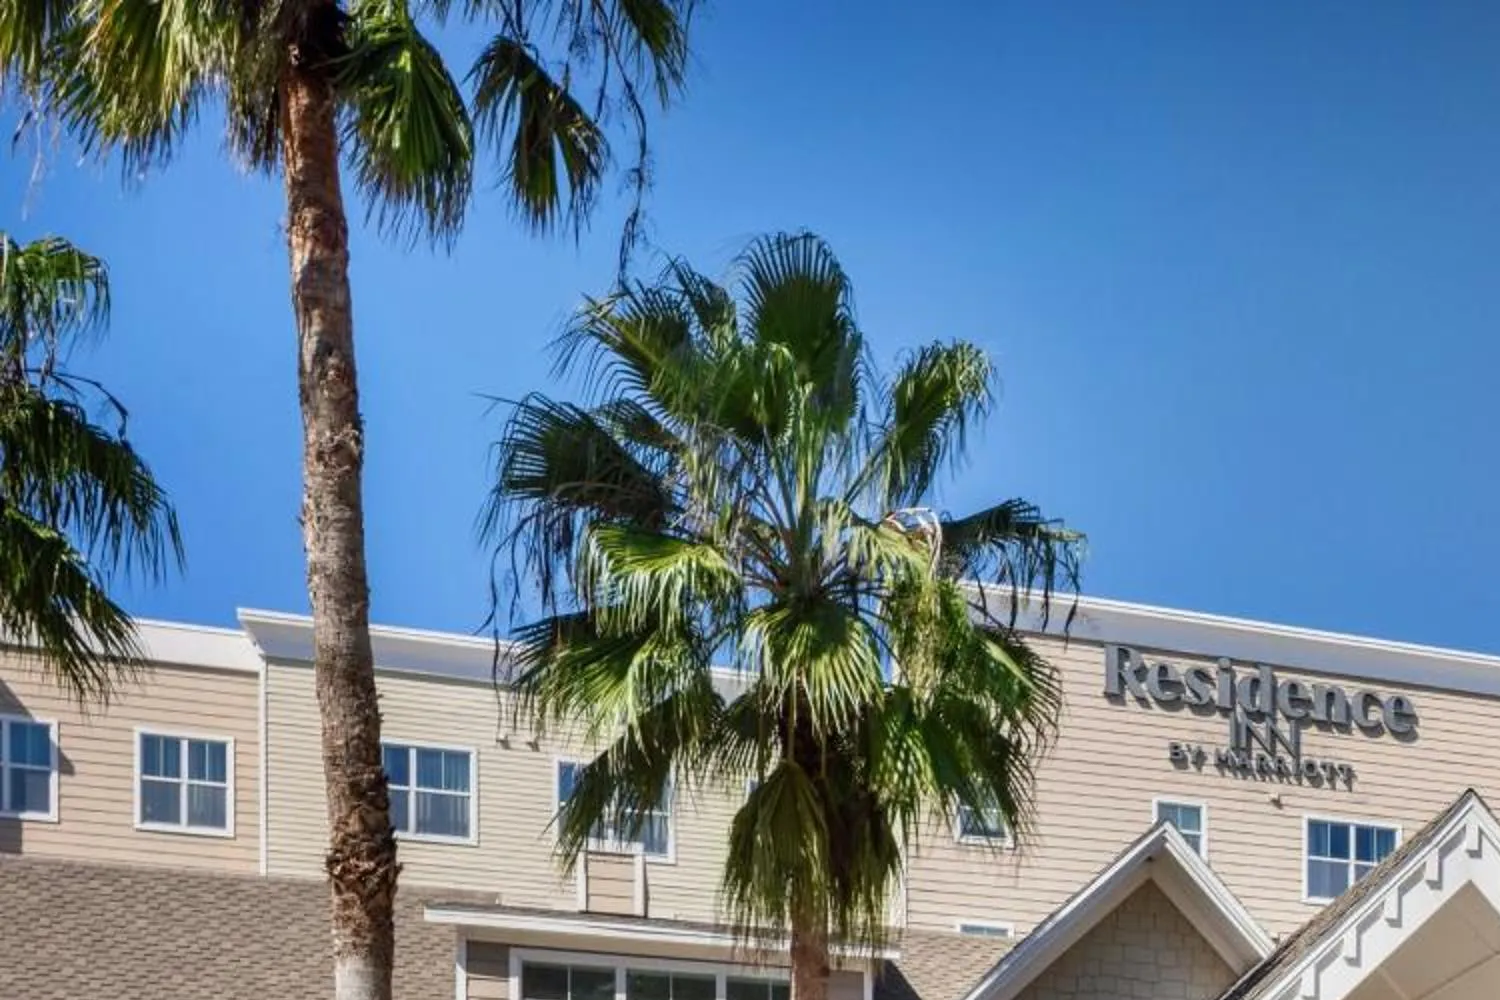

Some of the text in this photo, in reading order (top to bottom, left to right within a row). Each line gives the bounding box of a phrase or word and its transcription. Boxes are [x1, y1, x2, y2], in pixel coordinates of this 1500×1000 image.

[1104, 643, 1417, 735] Residence
[1229, 704, 1301, 760] INN
[1168, 741, 1354, 784] BY MARRIOTT
